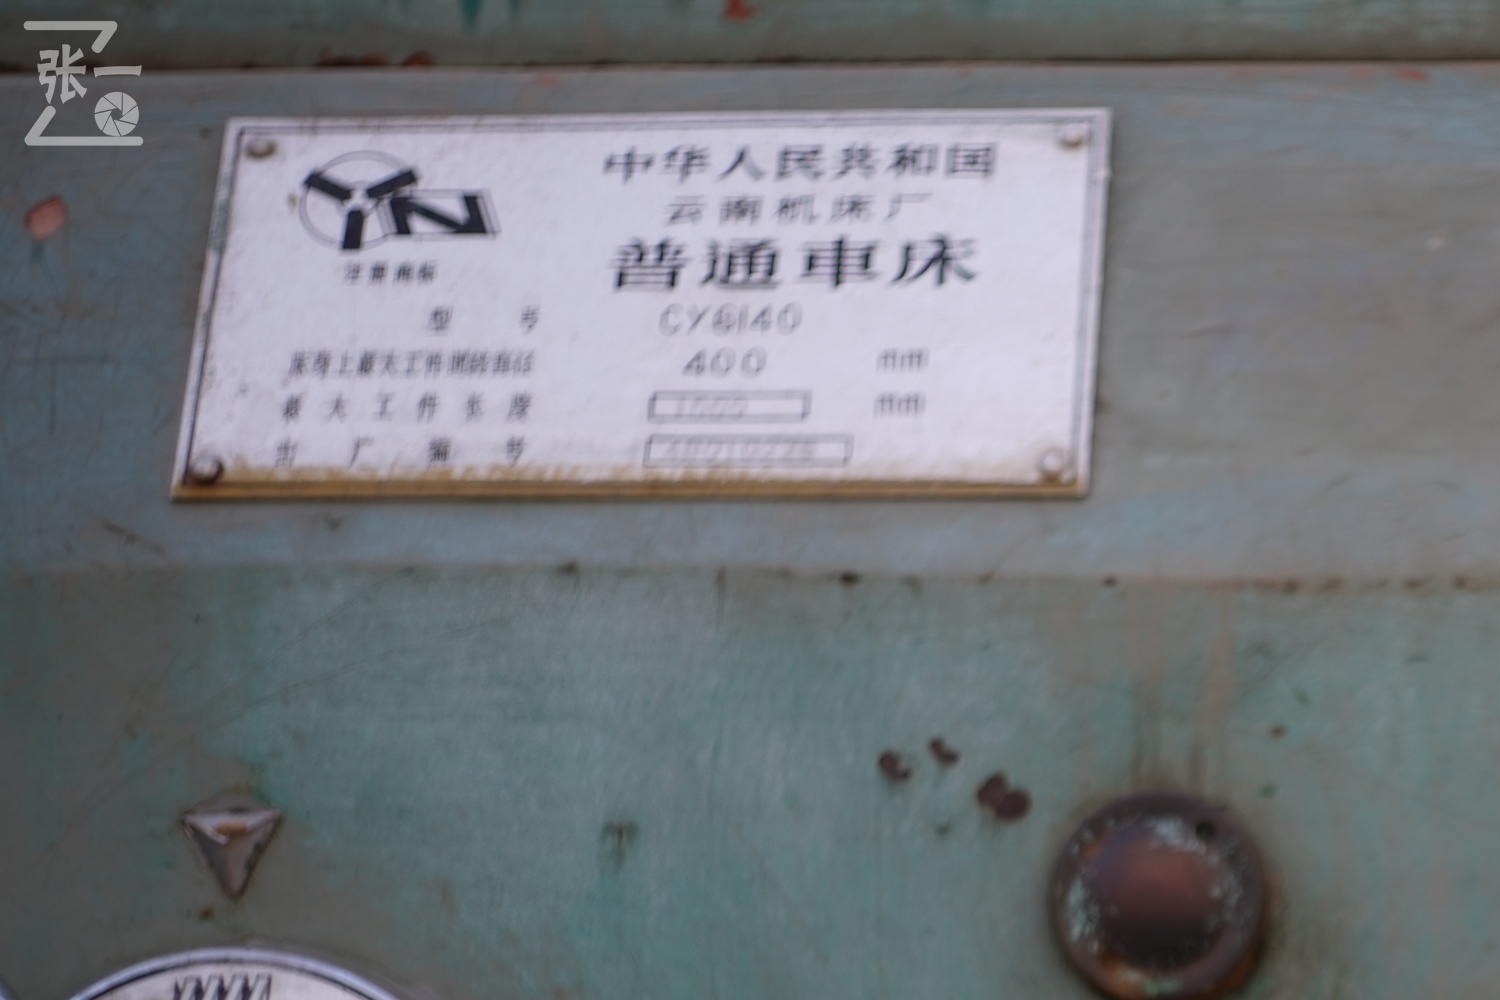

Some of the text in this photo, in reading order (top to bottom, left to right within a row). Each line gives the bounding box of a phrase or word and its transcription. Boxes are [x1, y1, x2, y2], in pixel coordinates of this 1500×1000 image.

[604, 141, 998, 184] 中华人民共和国
[666, 191, 932, 226] 云南机床厂
[659, 302, 803, 337] CY6140
[682, 346, 768, 379] 400
